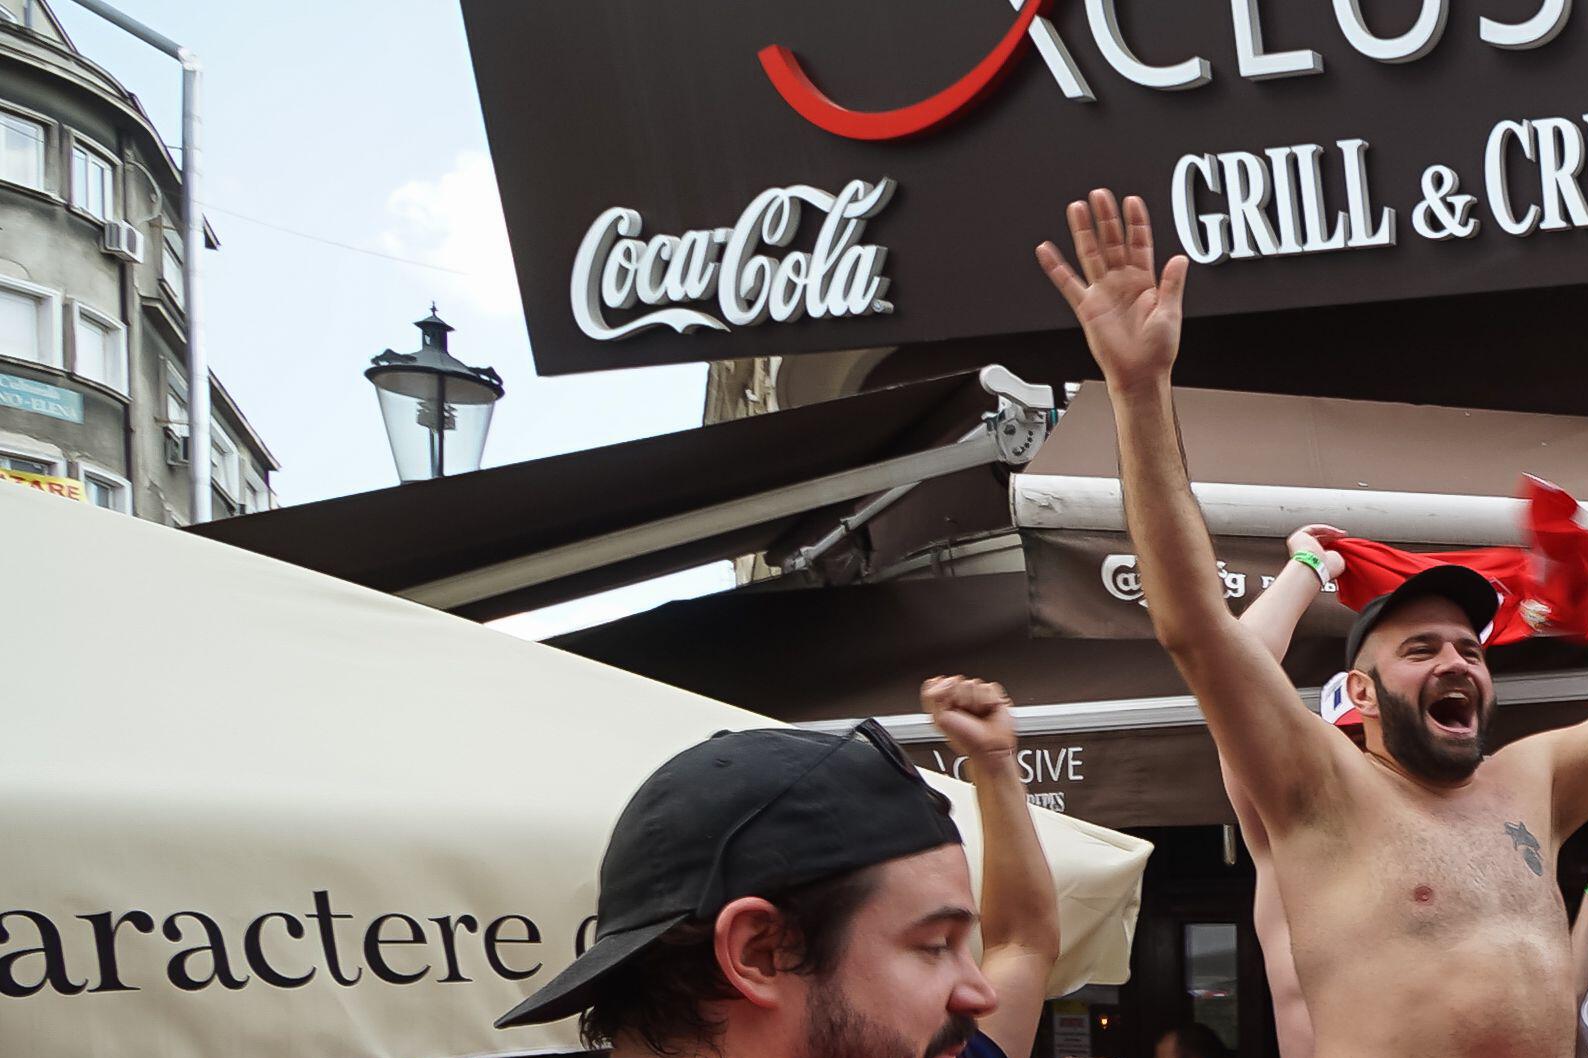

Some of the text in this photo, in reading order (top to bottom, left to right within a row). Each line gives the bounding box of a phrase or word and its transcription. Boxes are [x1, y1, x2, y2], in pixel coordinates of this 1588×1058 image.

[569, 176, 896, 341] Coca-Cola
[1171, 138, 1396, 265] GRILL
[1412, 164, 1481, 241] &
